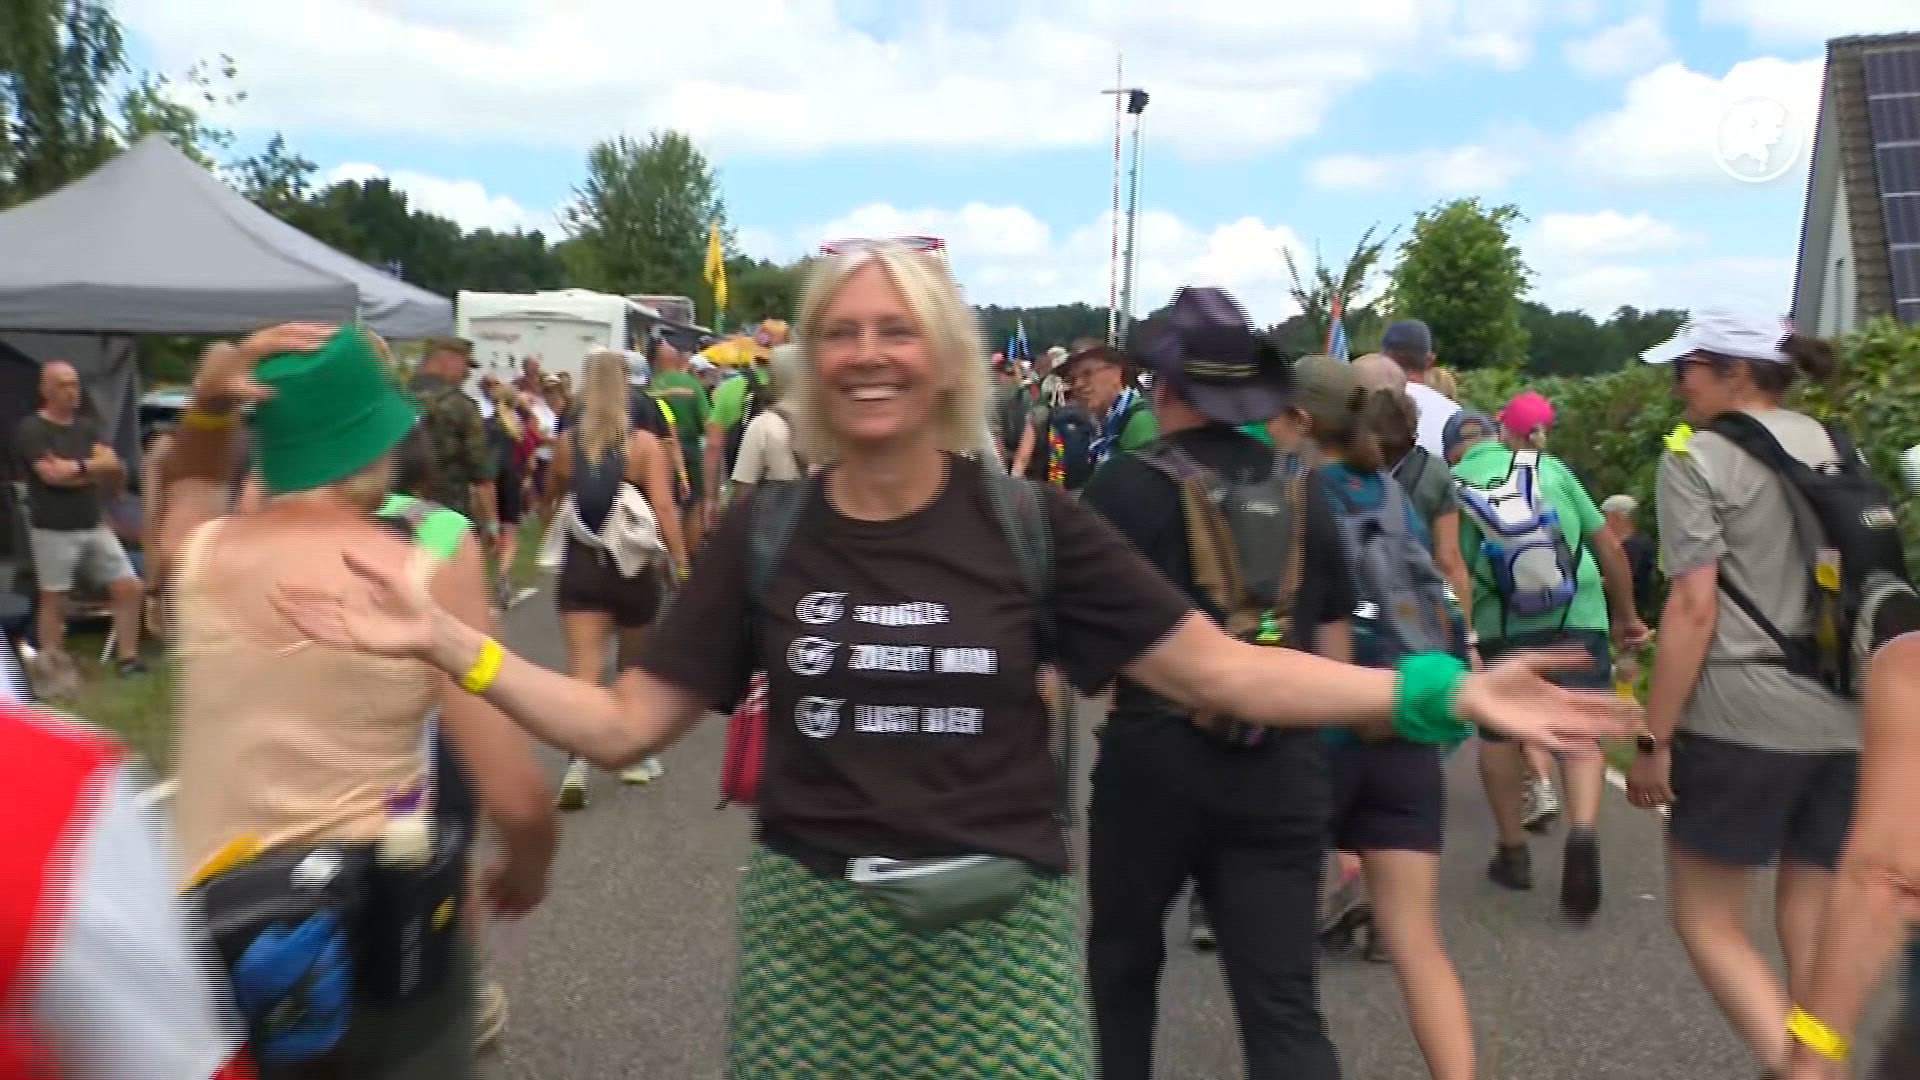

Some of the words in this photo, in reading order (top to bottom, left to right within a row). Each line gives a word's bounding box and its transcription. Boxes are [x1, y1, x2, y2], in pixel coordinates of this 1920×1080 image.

[852, 602, 949, 626] SINGLE
[848, 644, 931, 671] ZOEKT
[934, 648, 998, 674] MAN
[854, 705, 920, 733] LUST
[921, 707, 985, 734] BIER
